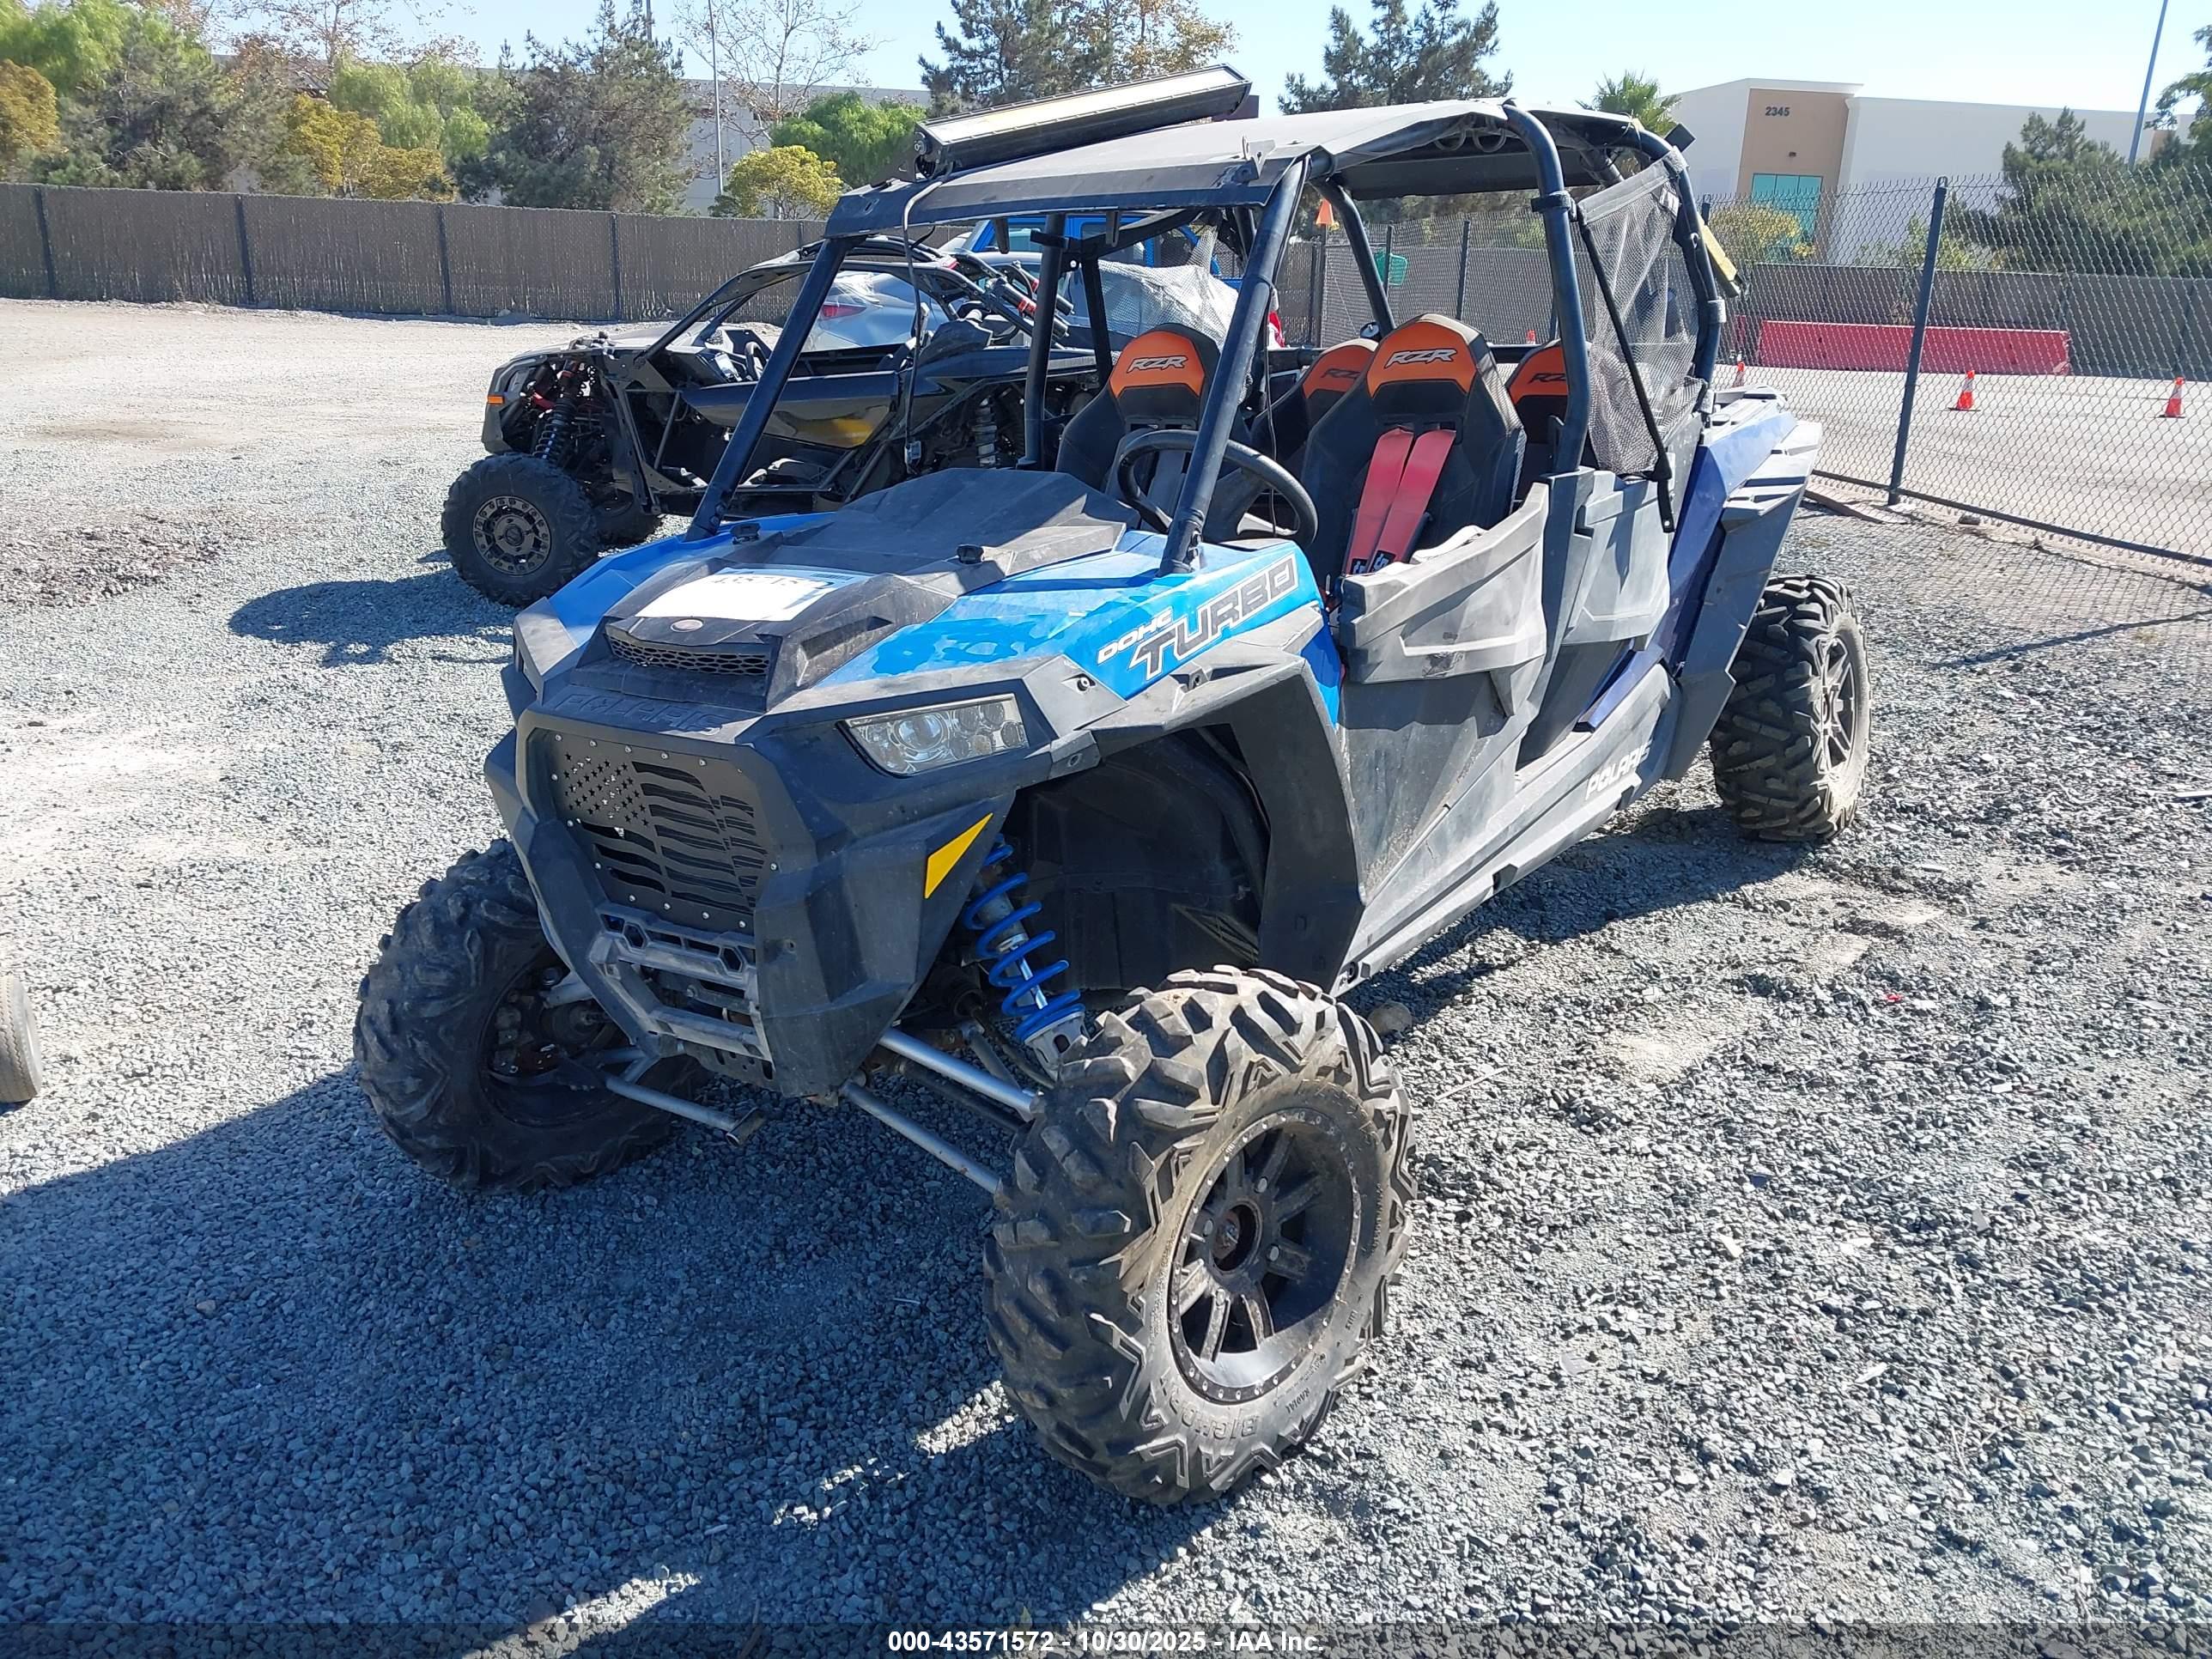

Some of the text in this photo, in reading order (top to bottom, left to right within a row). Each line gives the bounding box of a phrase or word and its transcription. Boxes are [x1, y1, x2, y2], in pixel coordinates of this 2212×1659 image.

[1765, 106, 1790, 117] 2345
[1127, 355, 1188, 374] RZR
[1383, 349, 1457, 369] RZR
[1321, 368, 1361, 380] RZ
[1528, 373, 1566, 385] RZ
[1127, 551, 1299, 681] TURBO
[1097, 606, 1175, 665] DOHC
[1584, 737, 1652, 800] POLARIS
